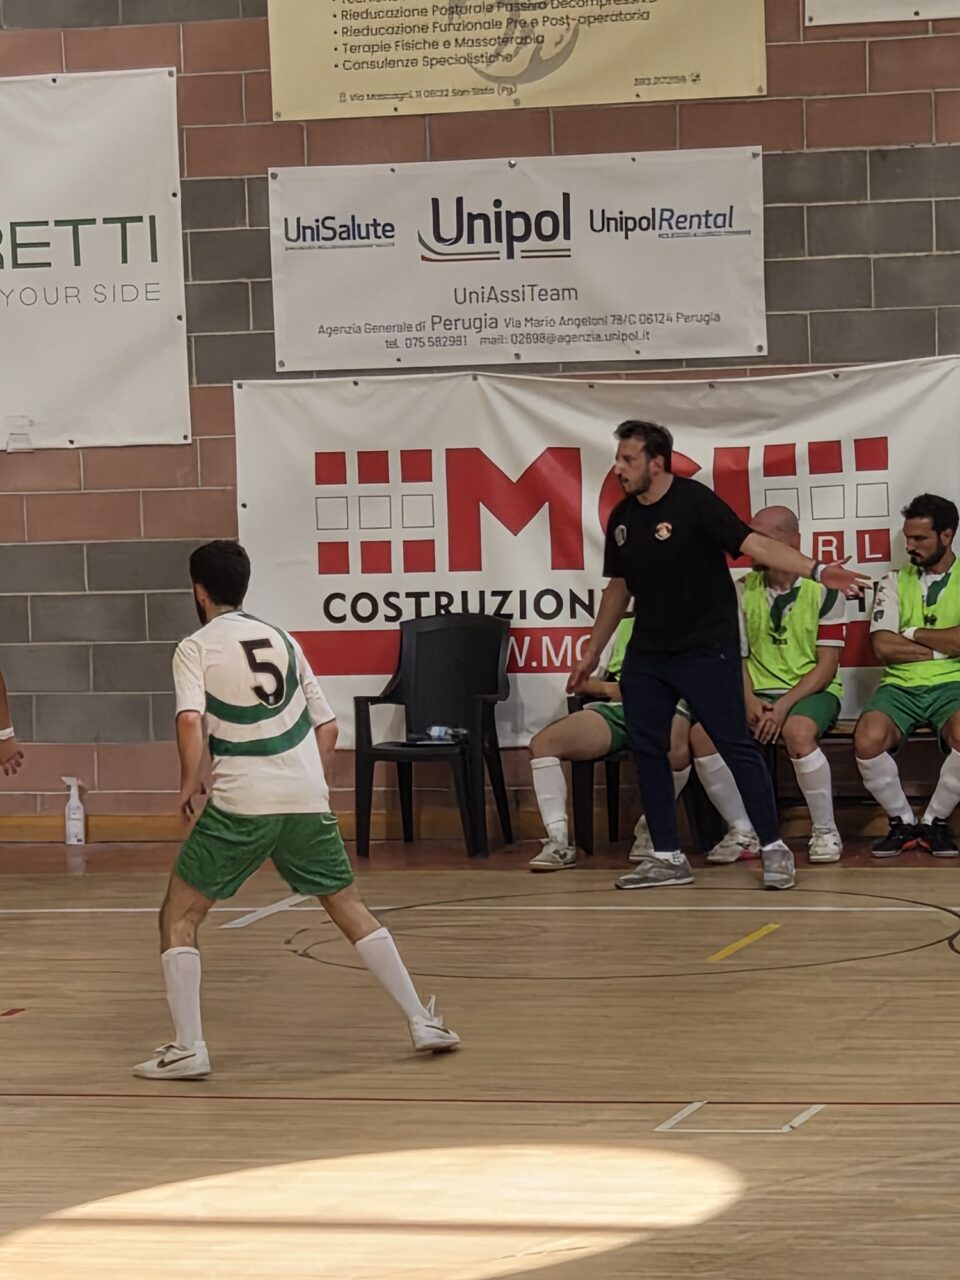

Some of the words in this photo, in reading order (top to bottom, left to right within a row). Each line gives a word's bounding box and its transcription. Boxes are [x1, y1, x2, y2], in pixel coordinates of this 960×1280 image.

[341, 6, 428, 20] Rieducazione
[432, 2, 493, 17] Posturale
[341, 23, 429, 37] Rieducazione
[432, 19, 502, 33] Funzionale
[506, 17, 528, 30] Pre
[529, 18, 539, 28] e
[342, 40, 392, 56] Terapie
[394, 38, 440, 52] Fisiche
[442, 39, 452, 49] e
[454, 33, 545, 49] Massoterapia
[342, 56, 419, 71] Consulenze
[422, 50, 513, 69] Specialistiche
[283, 214, 396, 243] UniSalute
[431, 191, 572, 260] Unipol
[589, 205, 734, 240] UnipolRental
[92, 282, 161, 304] SIDE
[453, 284, 579, 305] UniAssiTeam
[317, 323, 363, 338] Agenzia
[363, 321, 414, 335] Generale
[415, 320, 427, 333] di
[430, 313, 499, 334] Perugia
[504, 317, 522, 329] Via
[524, 315, 557, 328] Mario
[558, 313, 609, 331] Angeloni
[675, 311, 722, 326] Perugia
[404, 337, 426, 350] 075
[323, 588, 606, 624] COSTRUZION
[239, 638, 286, 707] 5
